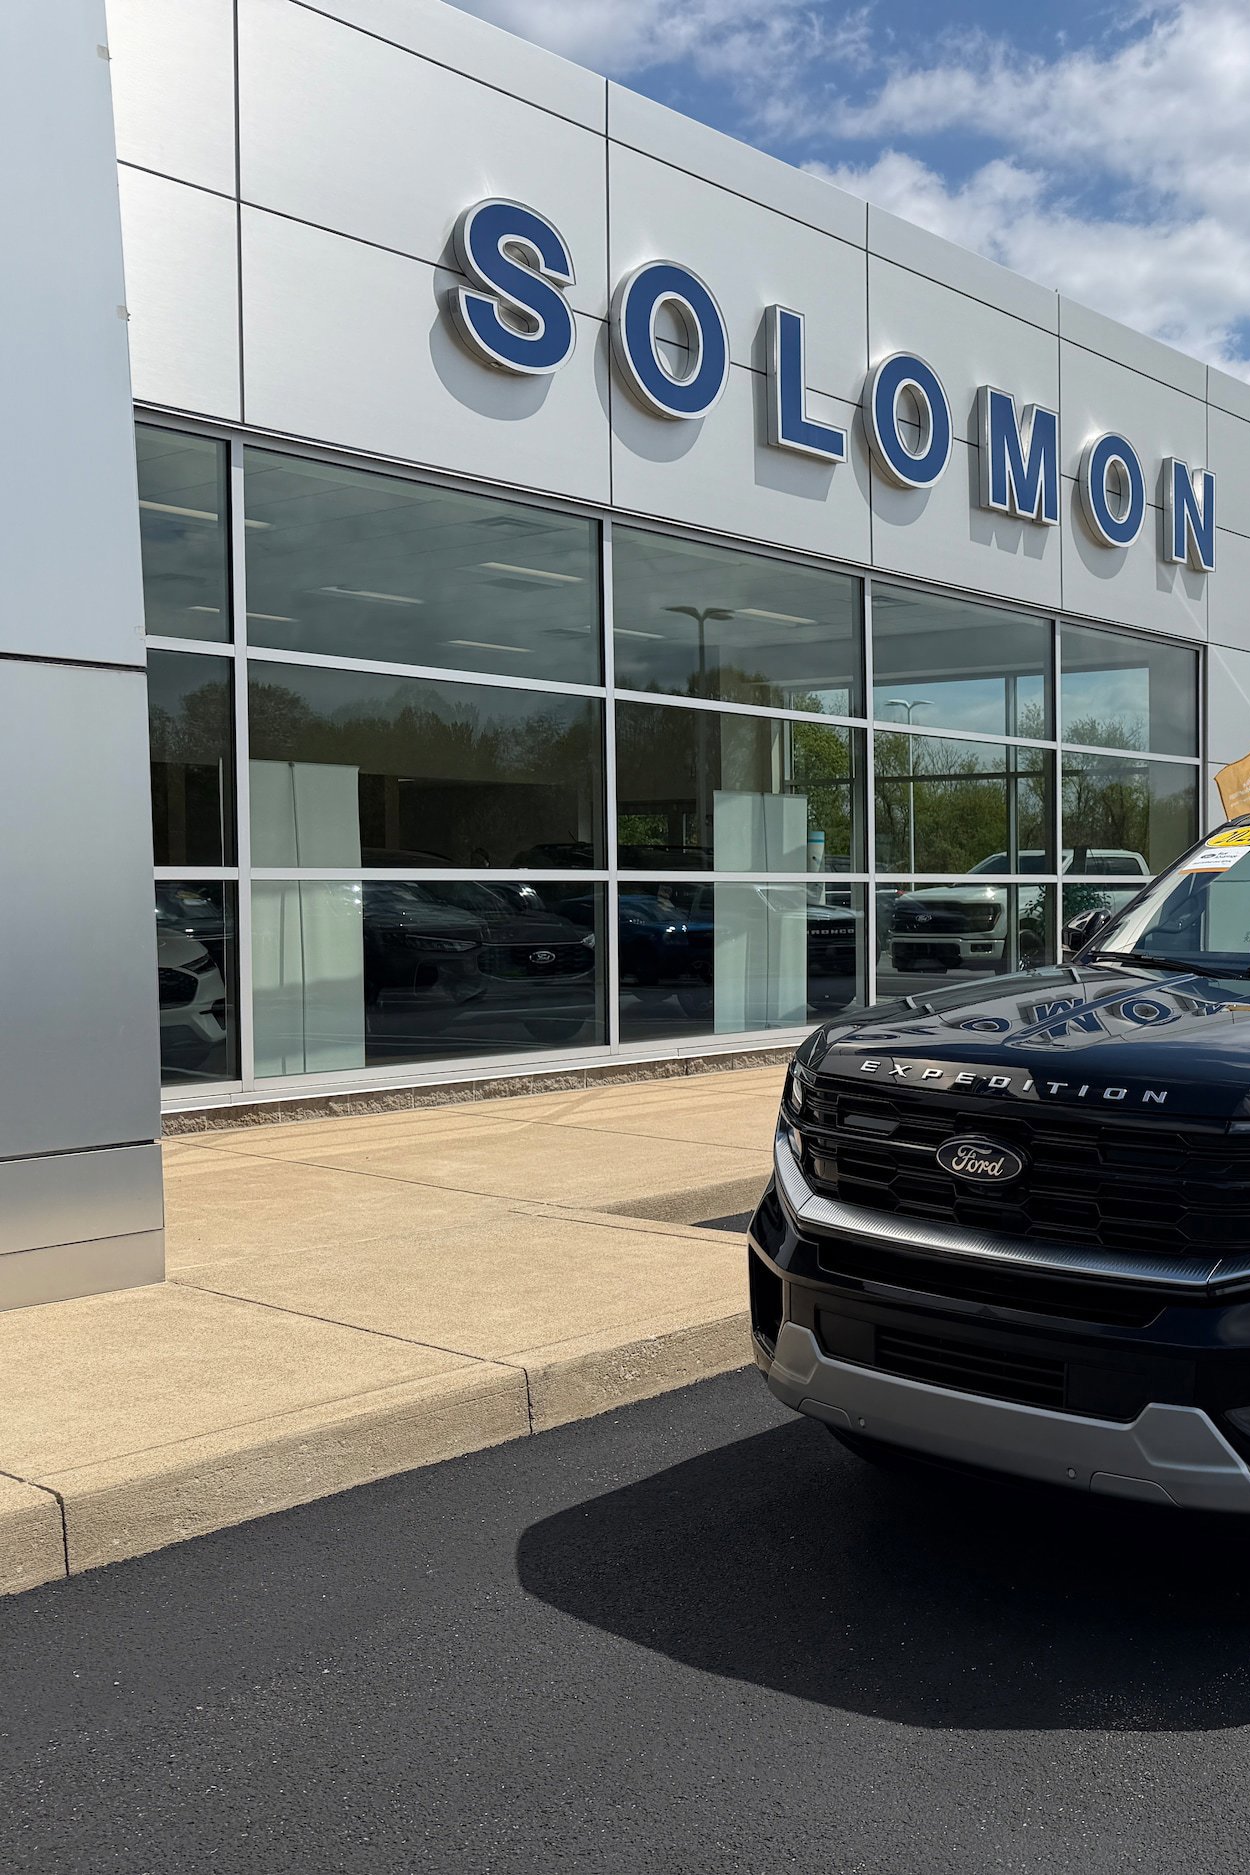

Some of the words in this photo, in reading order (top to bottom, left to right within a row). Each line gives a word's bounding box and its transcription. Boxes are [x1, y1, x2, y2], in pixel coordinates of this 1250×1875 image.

[448, 196, 1217, 573] SOLOMON
[807, 928, 855, 936] RONCO
[860, 1060, 1168, 1104] EXPEDITION
[951, 1144, 1005, 1177] Ford
